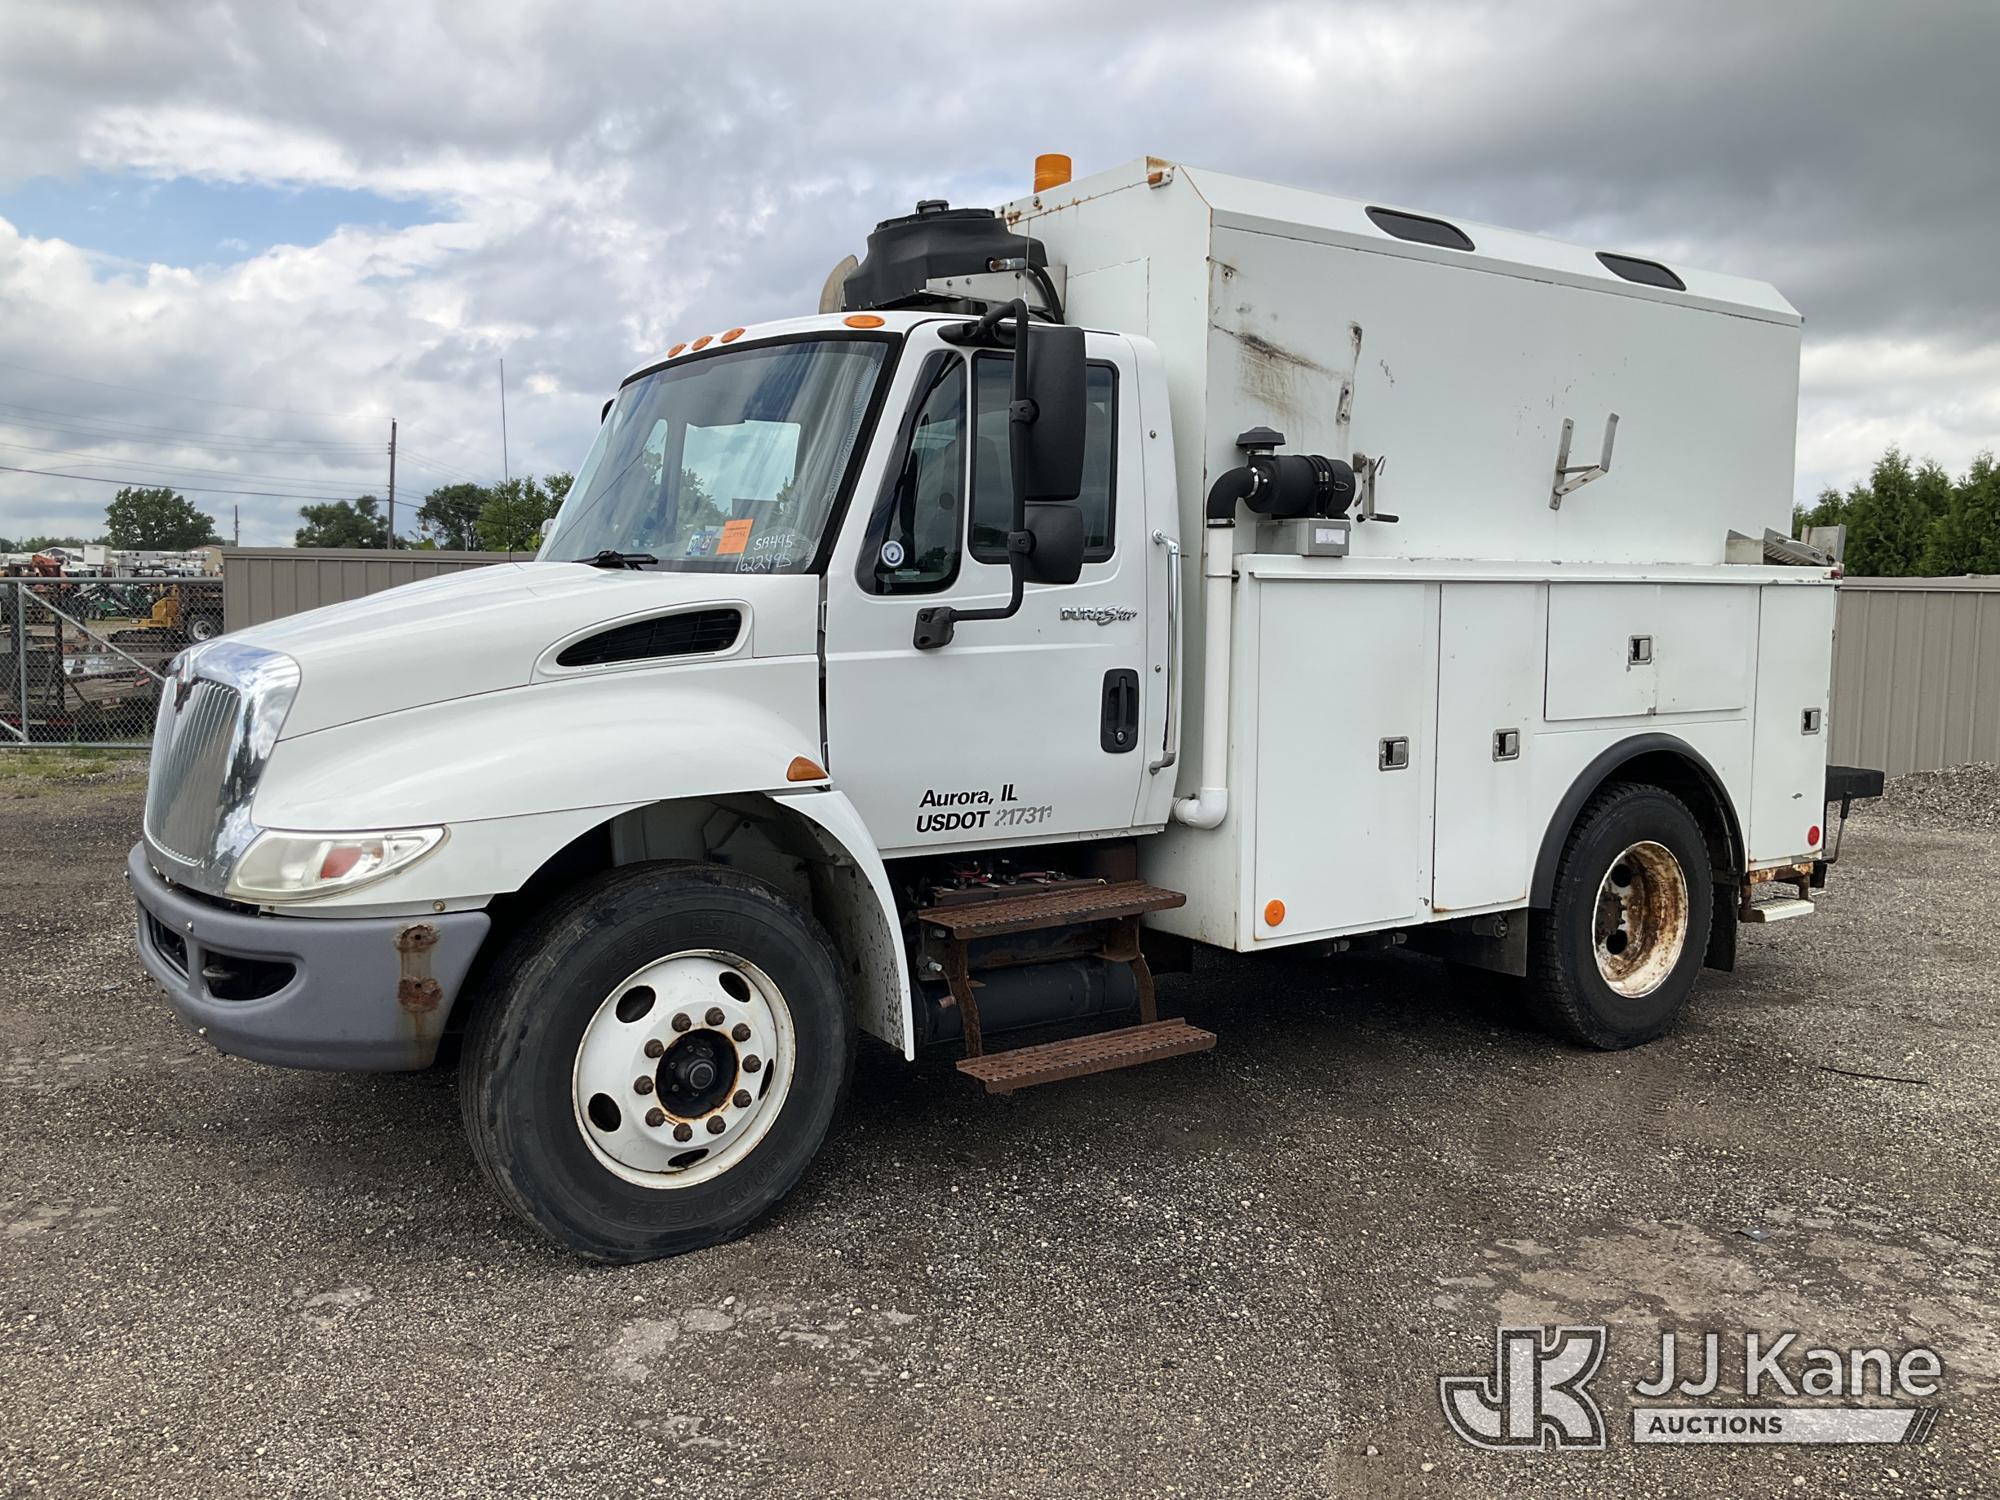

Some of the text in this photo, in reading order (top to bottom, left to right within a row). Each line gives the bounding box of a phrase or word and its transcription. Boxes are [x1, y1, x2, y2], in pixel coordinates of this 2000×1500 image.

[919, 783, 1018, 808] Aurora, IL
[916, 810, 990, 832] USDOT
